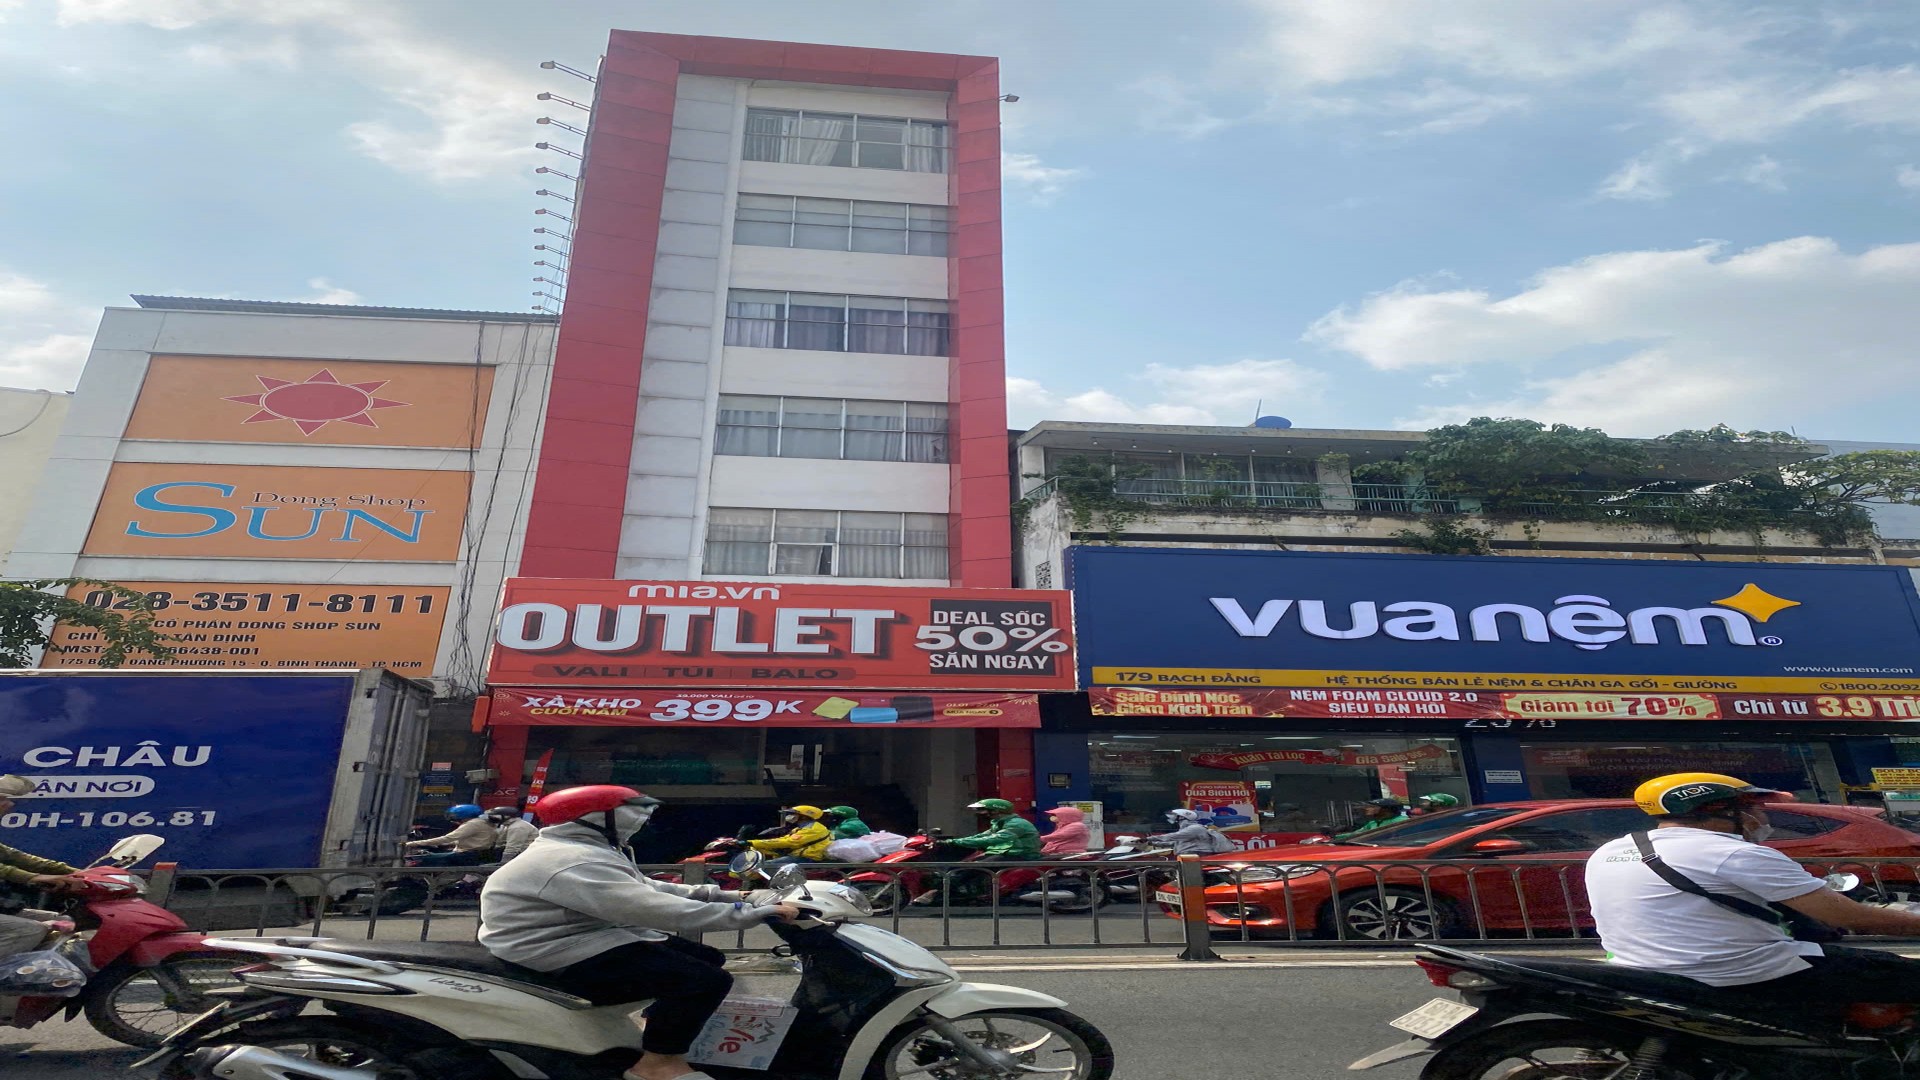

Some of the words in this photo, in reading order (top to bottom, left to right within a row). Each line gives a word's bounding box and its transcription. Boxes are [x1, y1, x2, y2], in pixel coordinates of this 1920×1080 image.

[84, 590, 434, 614] 028-3511-8111
[934, 611, 994, 625] DEAL
[1000, 608, 1046, 626] SỐC
[292, 622, 339, 630] SHOP
[345, 622, 381, 631] SUN
[496, 602, 895, 655] OUTLET
[914, 625, 1069, 653] 50%
[930, 652, 977, 669] SĂN
[985, 655, 1049, 670] NGAY
[1783, 665, 1914, 674] www.vuanem.com
[553, 666, 628, 678] VALI
[751, 668, 838, 679] BALO
[1116, 672, 1153, 682] 179
[574, 698, 642, 709] KHO
[1116, 692, 1156, 703] Sale
[1332, 690, 1380, 701] FOAM
[1386, 692, 1443, 702] CLOUD
[1449, 693, 1478, 702] 2.0
[650, 700, 803, 721] 399K
[1621, 697, 1697, 716] 70%
[23, 740, 211, 768] CHÂU
[33, 779, 77, 796] ẬN
[85, 780, 142, 793] NƠI
